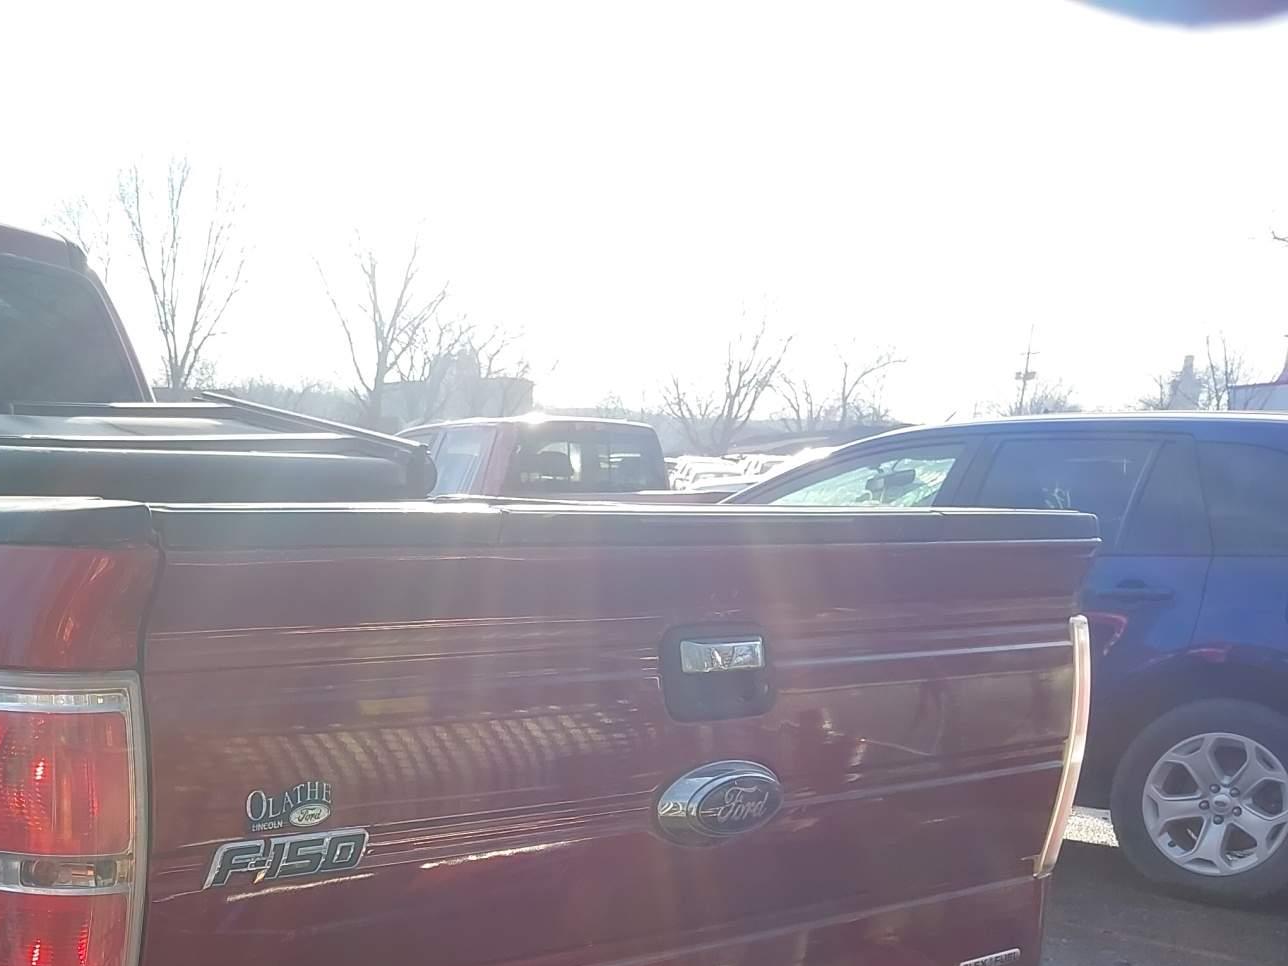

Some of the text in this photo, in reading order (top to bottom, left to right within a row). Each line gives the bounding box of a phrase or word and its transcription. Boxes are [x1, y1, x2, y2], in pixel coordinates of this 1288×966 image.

[717, 786, 769, 823] Ford
[252, 819, 284, 832] LINCOLN
[203, 828, 370, 889] F-150
